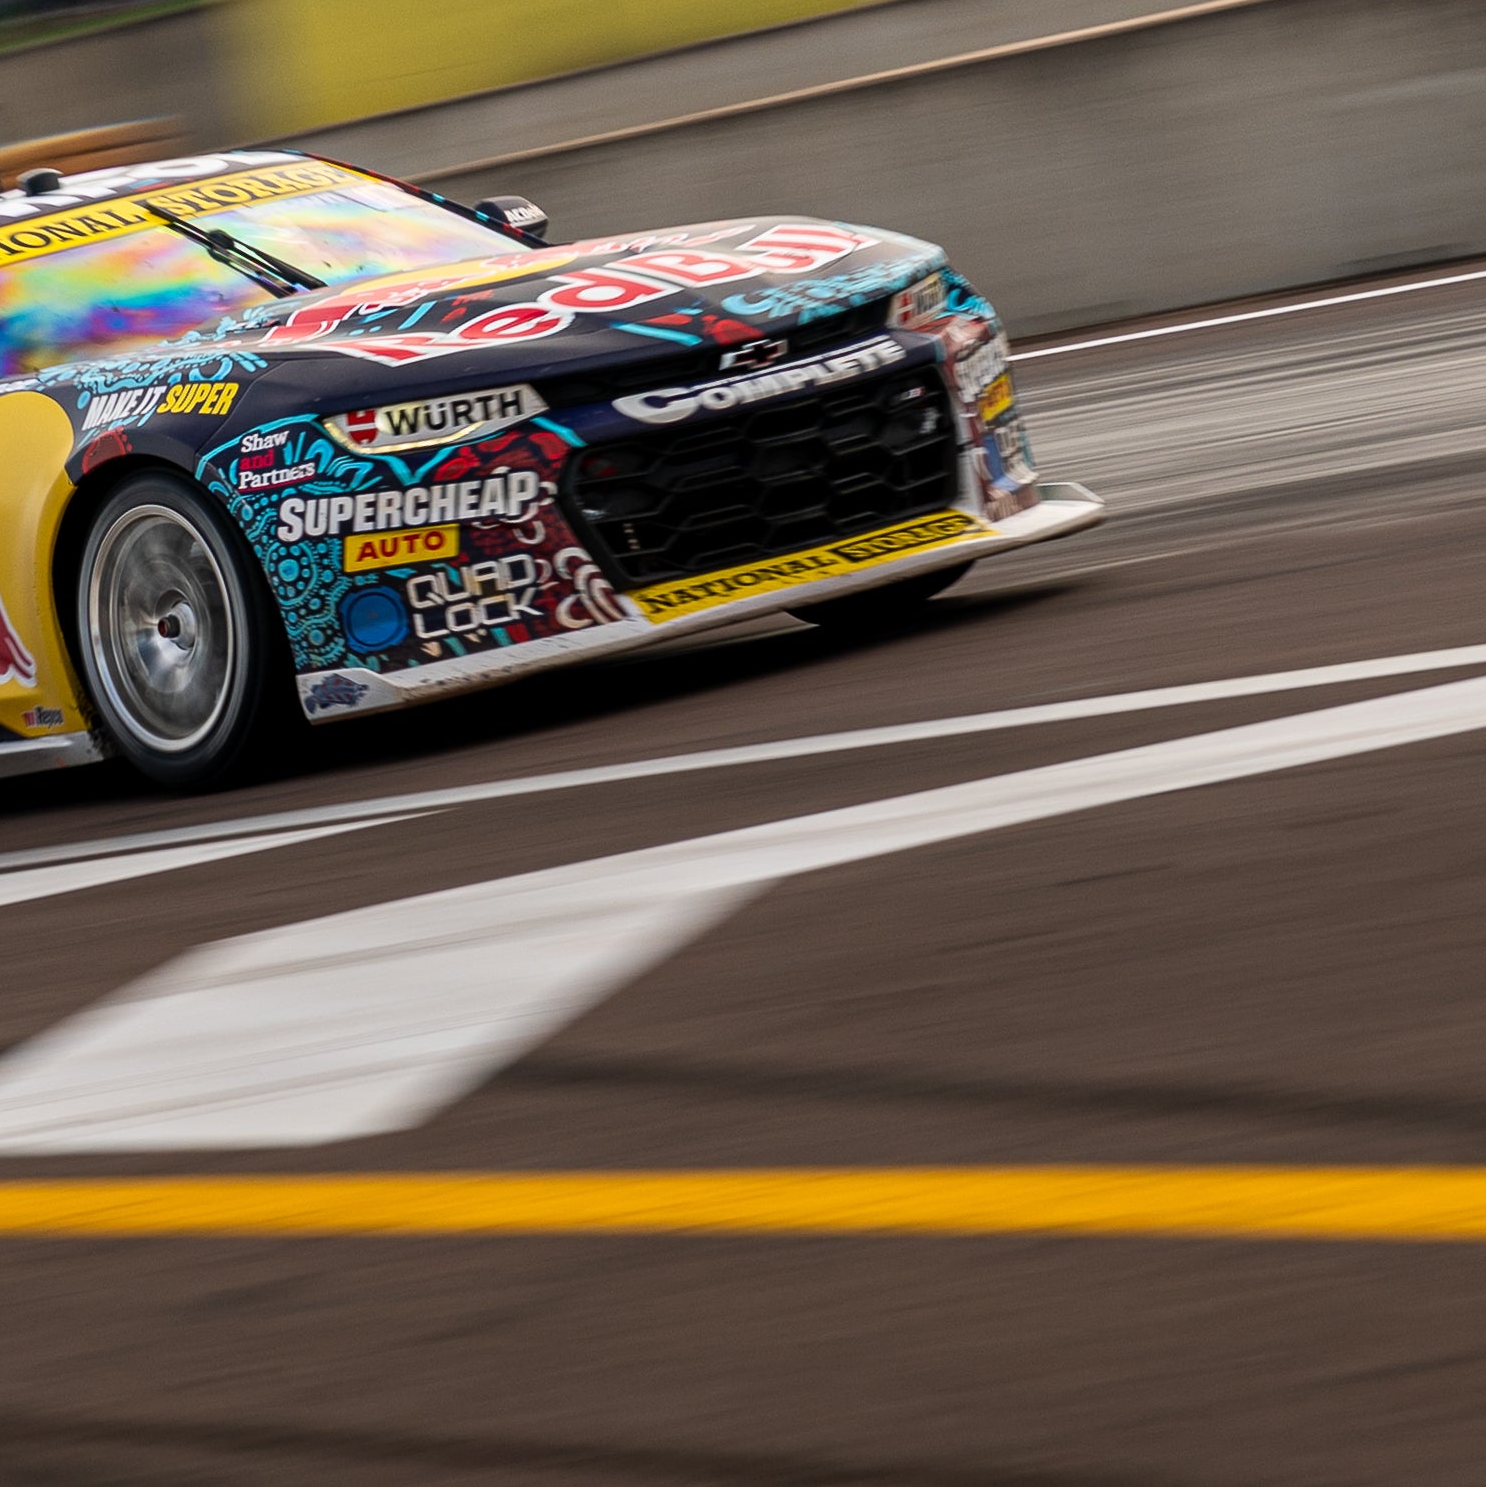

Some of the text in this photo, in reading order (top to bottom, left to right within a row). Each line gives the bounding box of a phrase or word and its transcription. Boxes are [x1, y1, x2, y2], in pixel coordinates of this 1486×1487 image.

[146, 166, 354, 216] STORAGE
[82, 390, 143, 431] MAKE
[156, 383, 240, 415] SUPER
[611, 339, 907, 425] COMPLETE
[238, 450, 274, 470] and
[240, 430, 290, 454] Shaw
[238, 462, 315, 490] Partners
[277, 471, 540, 542] SUPERCHEAP
[355, 530, 446, 562] AUTO
[406, 553, 537, 609] QUAD
[642, 554, 840, 614] NATIONAL
[413, 587, 545, 639] LOCK
